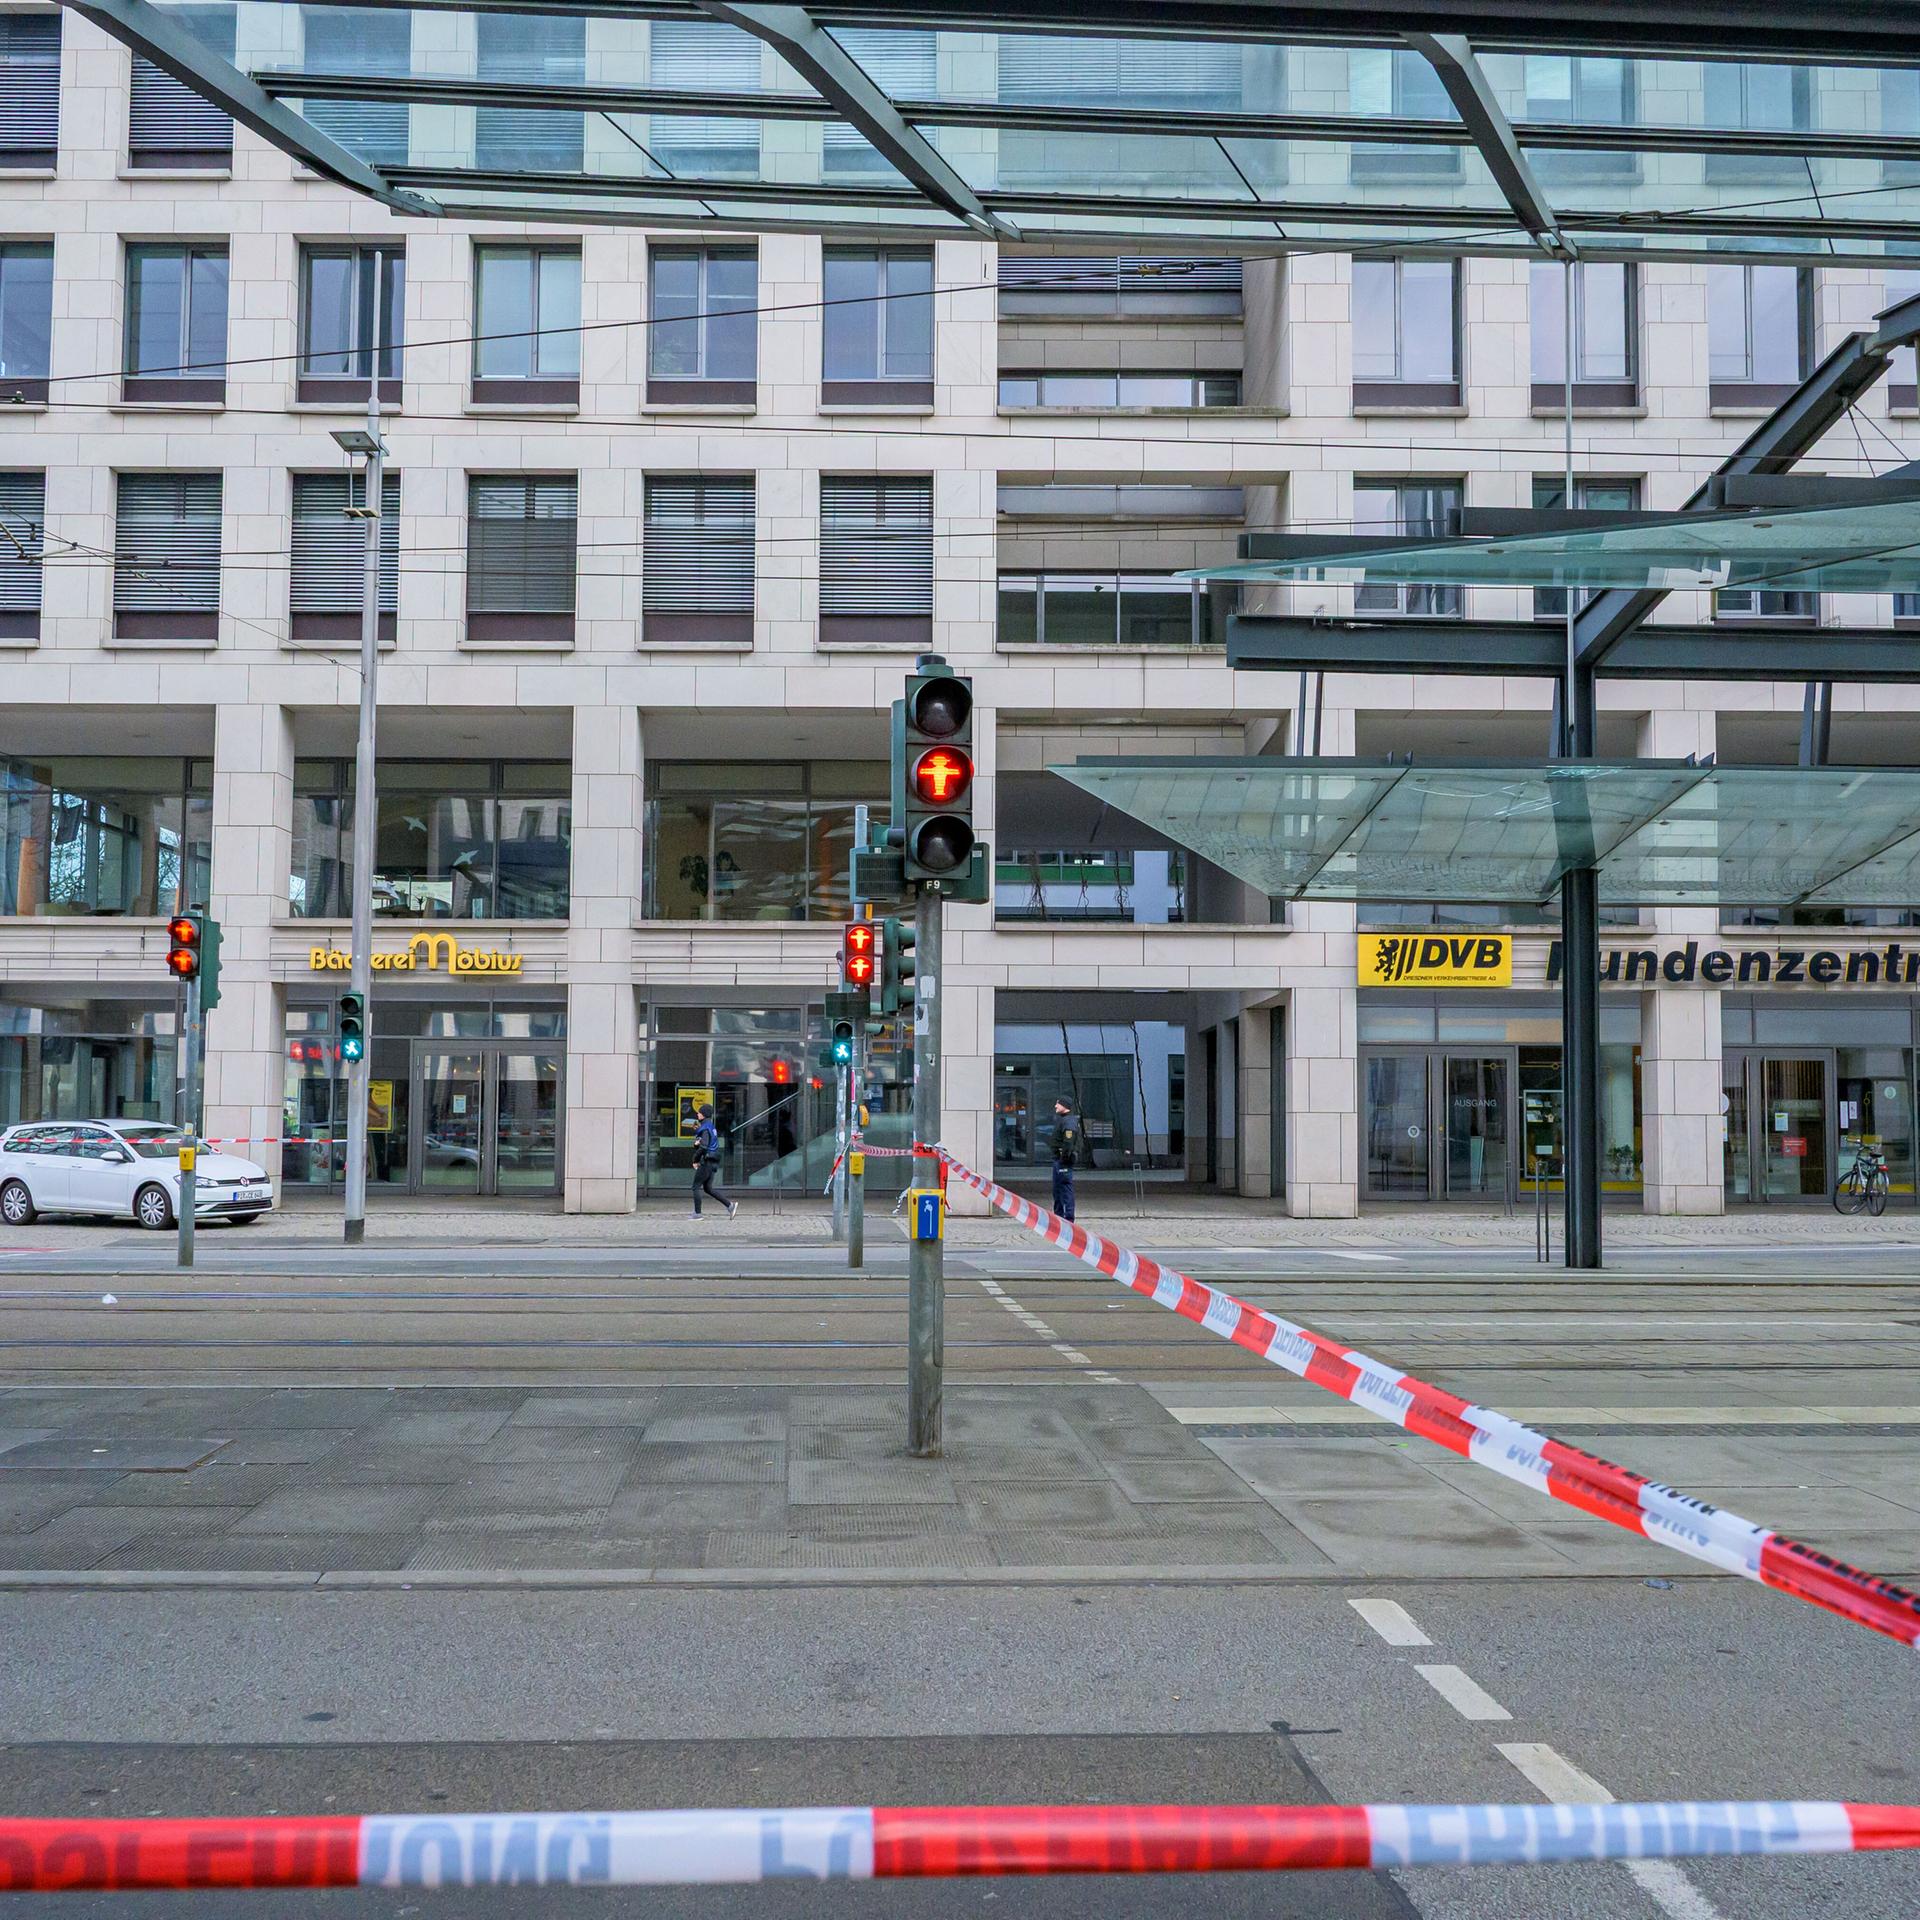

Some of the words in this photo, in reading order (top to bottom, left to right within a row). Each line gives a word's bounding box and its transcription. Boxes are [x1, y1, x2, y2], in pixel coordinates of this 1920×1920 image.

[310, 945, 416, 970] Bäcerei
[408, 933, 523, 975] Möbius
[1419, 939, 1502, 968] DVB
[1454, 1099, 1497, 1107] AUSGANG
